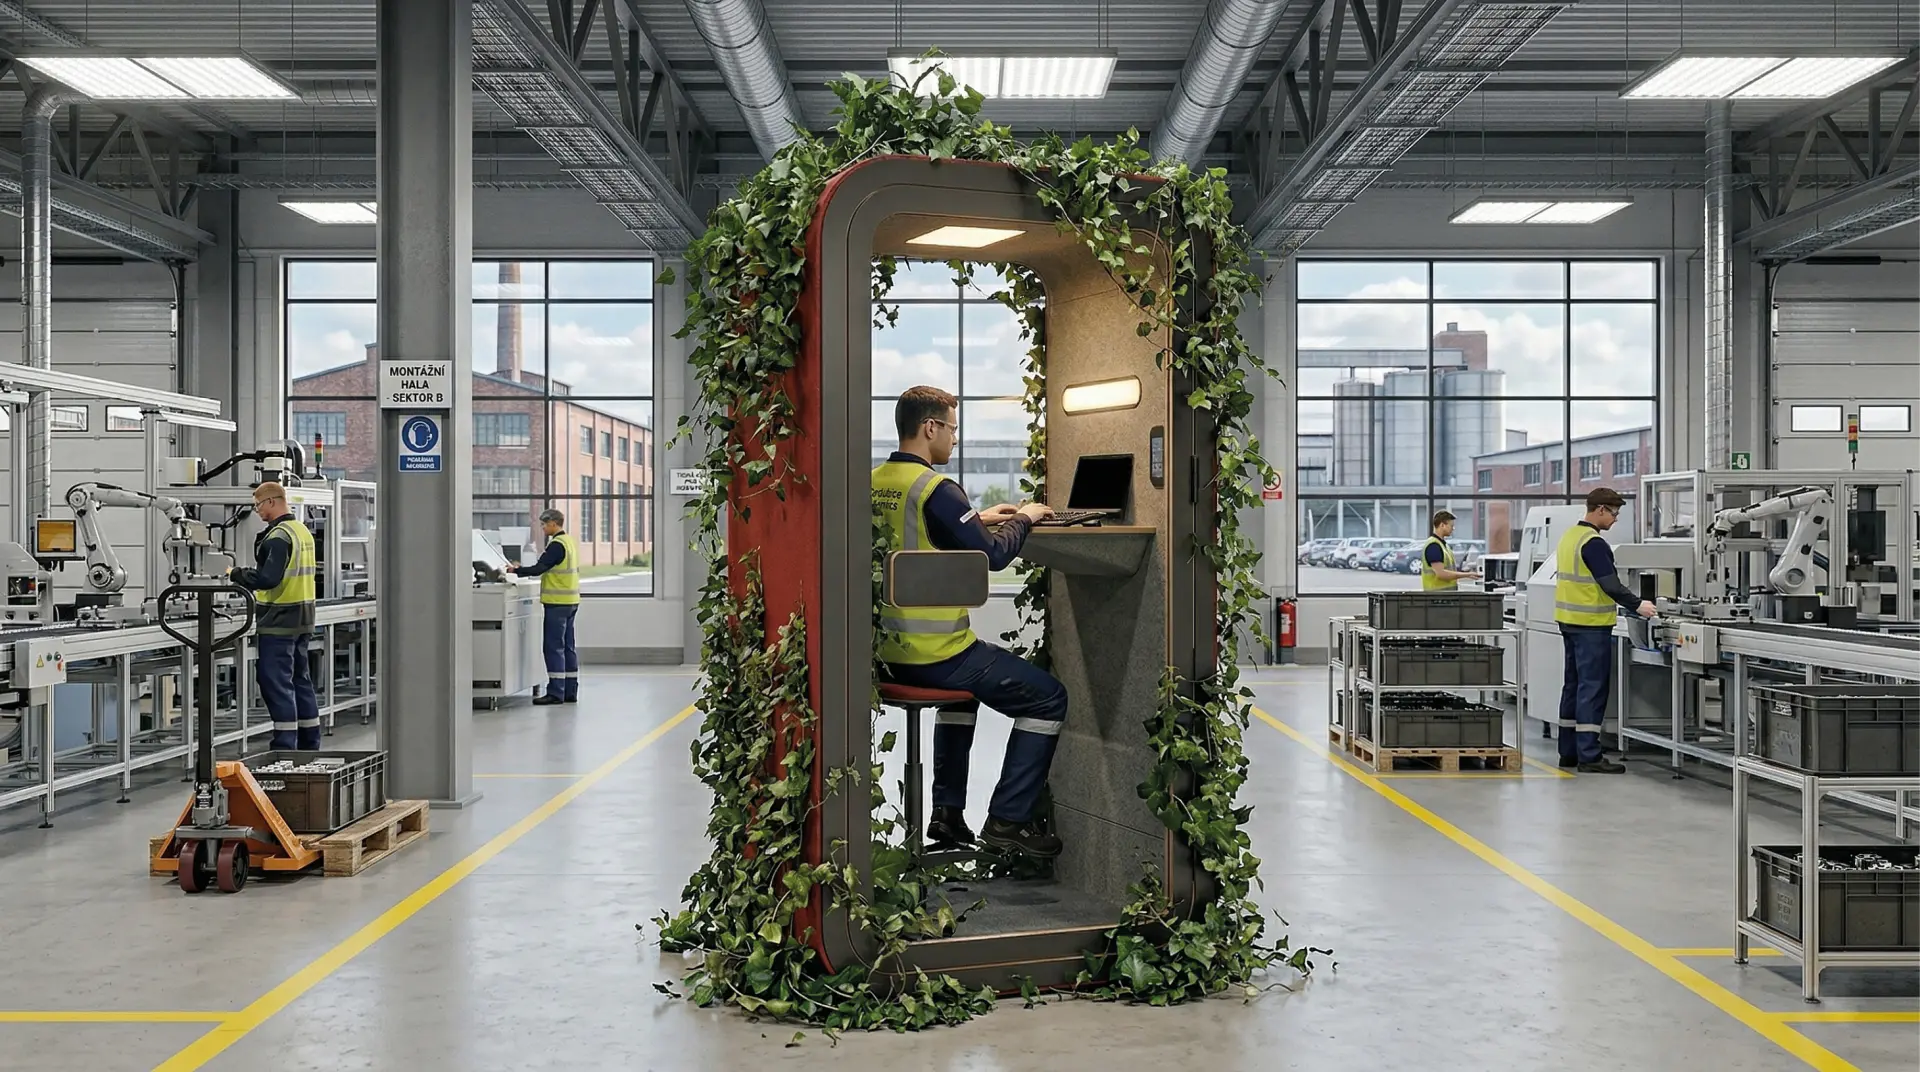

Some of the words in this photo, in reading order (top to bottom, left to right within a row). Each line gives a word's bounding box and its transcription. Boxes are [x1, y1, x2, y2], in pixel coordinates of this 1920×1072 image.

[389, 364, 446, 377] MONTÁŽNÍ
[401, 380, 430, 390] HALA
[392, 393, 434, 403] SEKTOR
[436, 393, 444, 402] B
